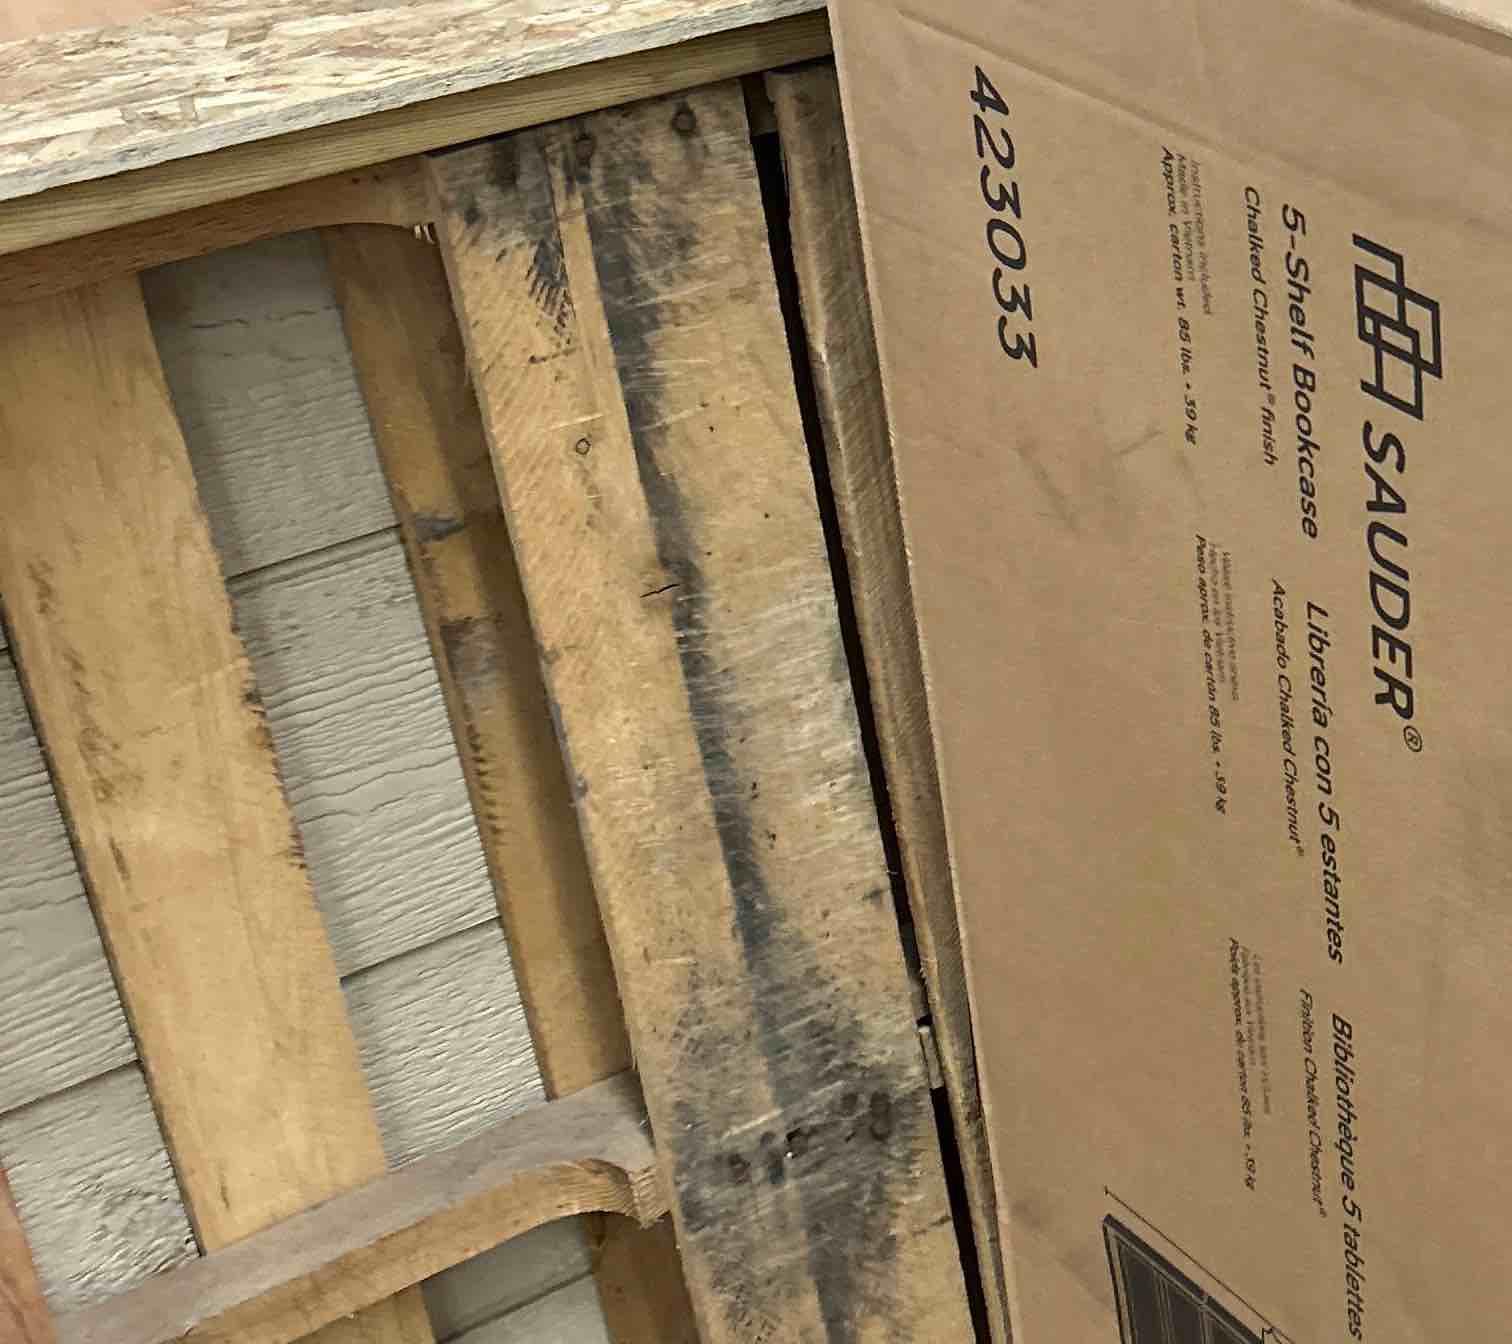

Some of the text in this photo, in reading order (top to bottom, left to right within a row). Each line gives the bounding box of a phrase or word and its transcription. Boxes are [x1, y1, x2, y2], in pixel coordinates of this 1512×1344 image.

[969, 64, 1038, 369] 423033
[1169, 223, 1183, 283] carton
[1244, 186, 1265, 284] Chalked
[1258, 406, 1279, 467] finish
[1282, 203, 1321, 540] 5-Shelf Bookcase
[1272, 576, 1290, 669] Acabado
[1278, 672, 1297, 757] Chalked
[1307, 600, 1344, 965] Librería con 5 estantes
[1304, 1056, 1321, 1128] Chalked
[1331, 1012, 1367, 1342] Bibliothèque 5 tablettes
